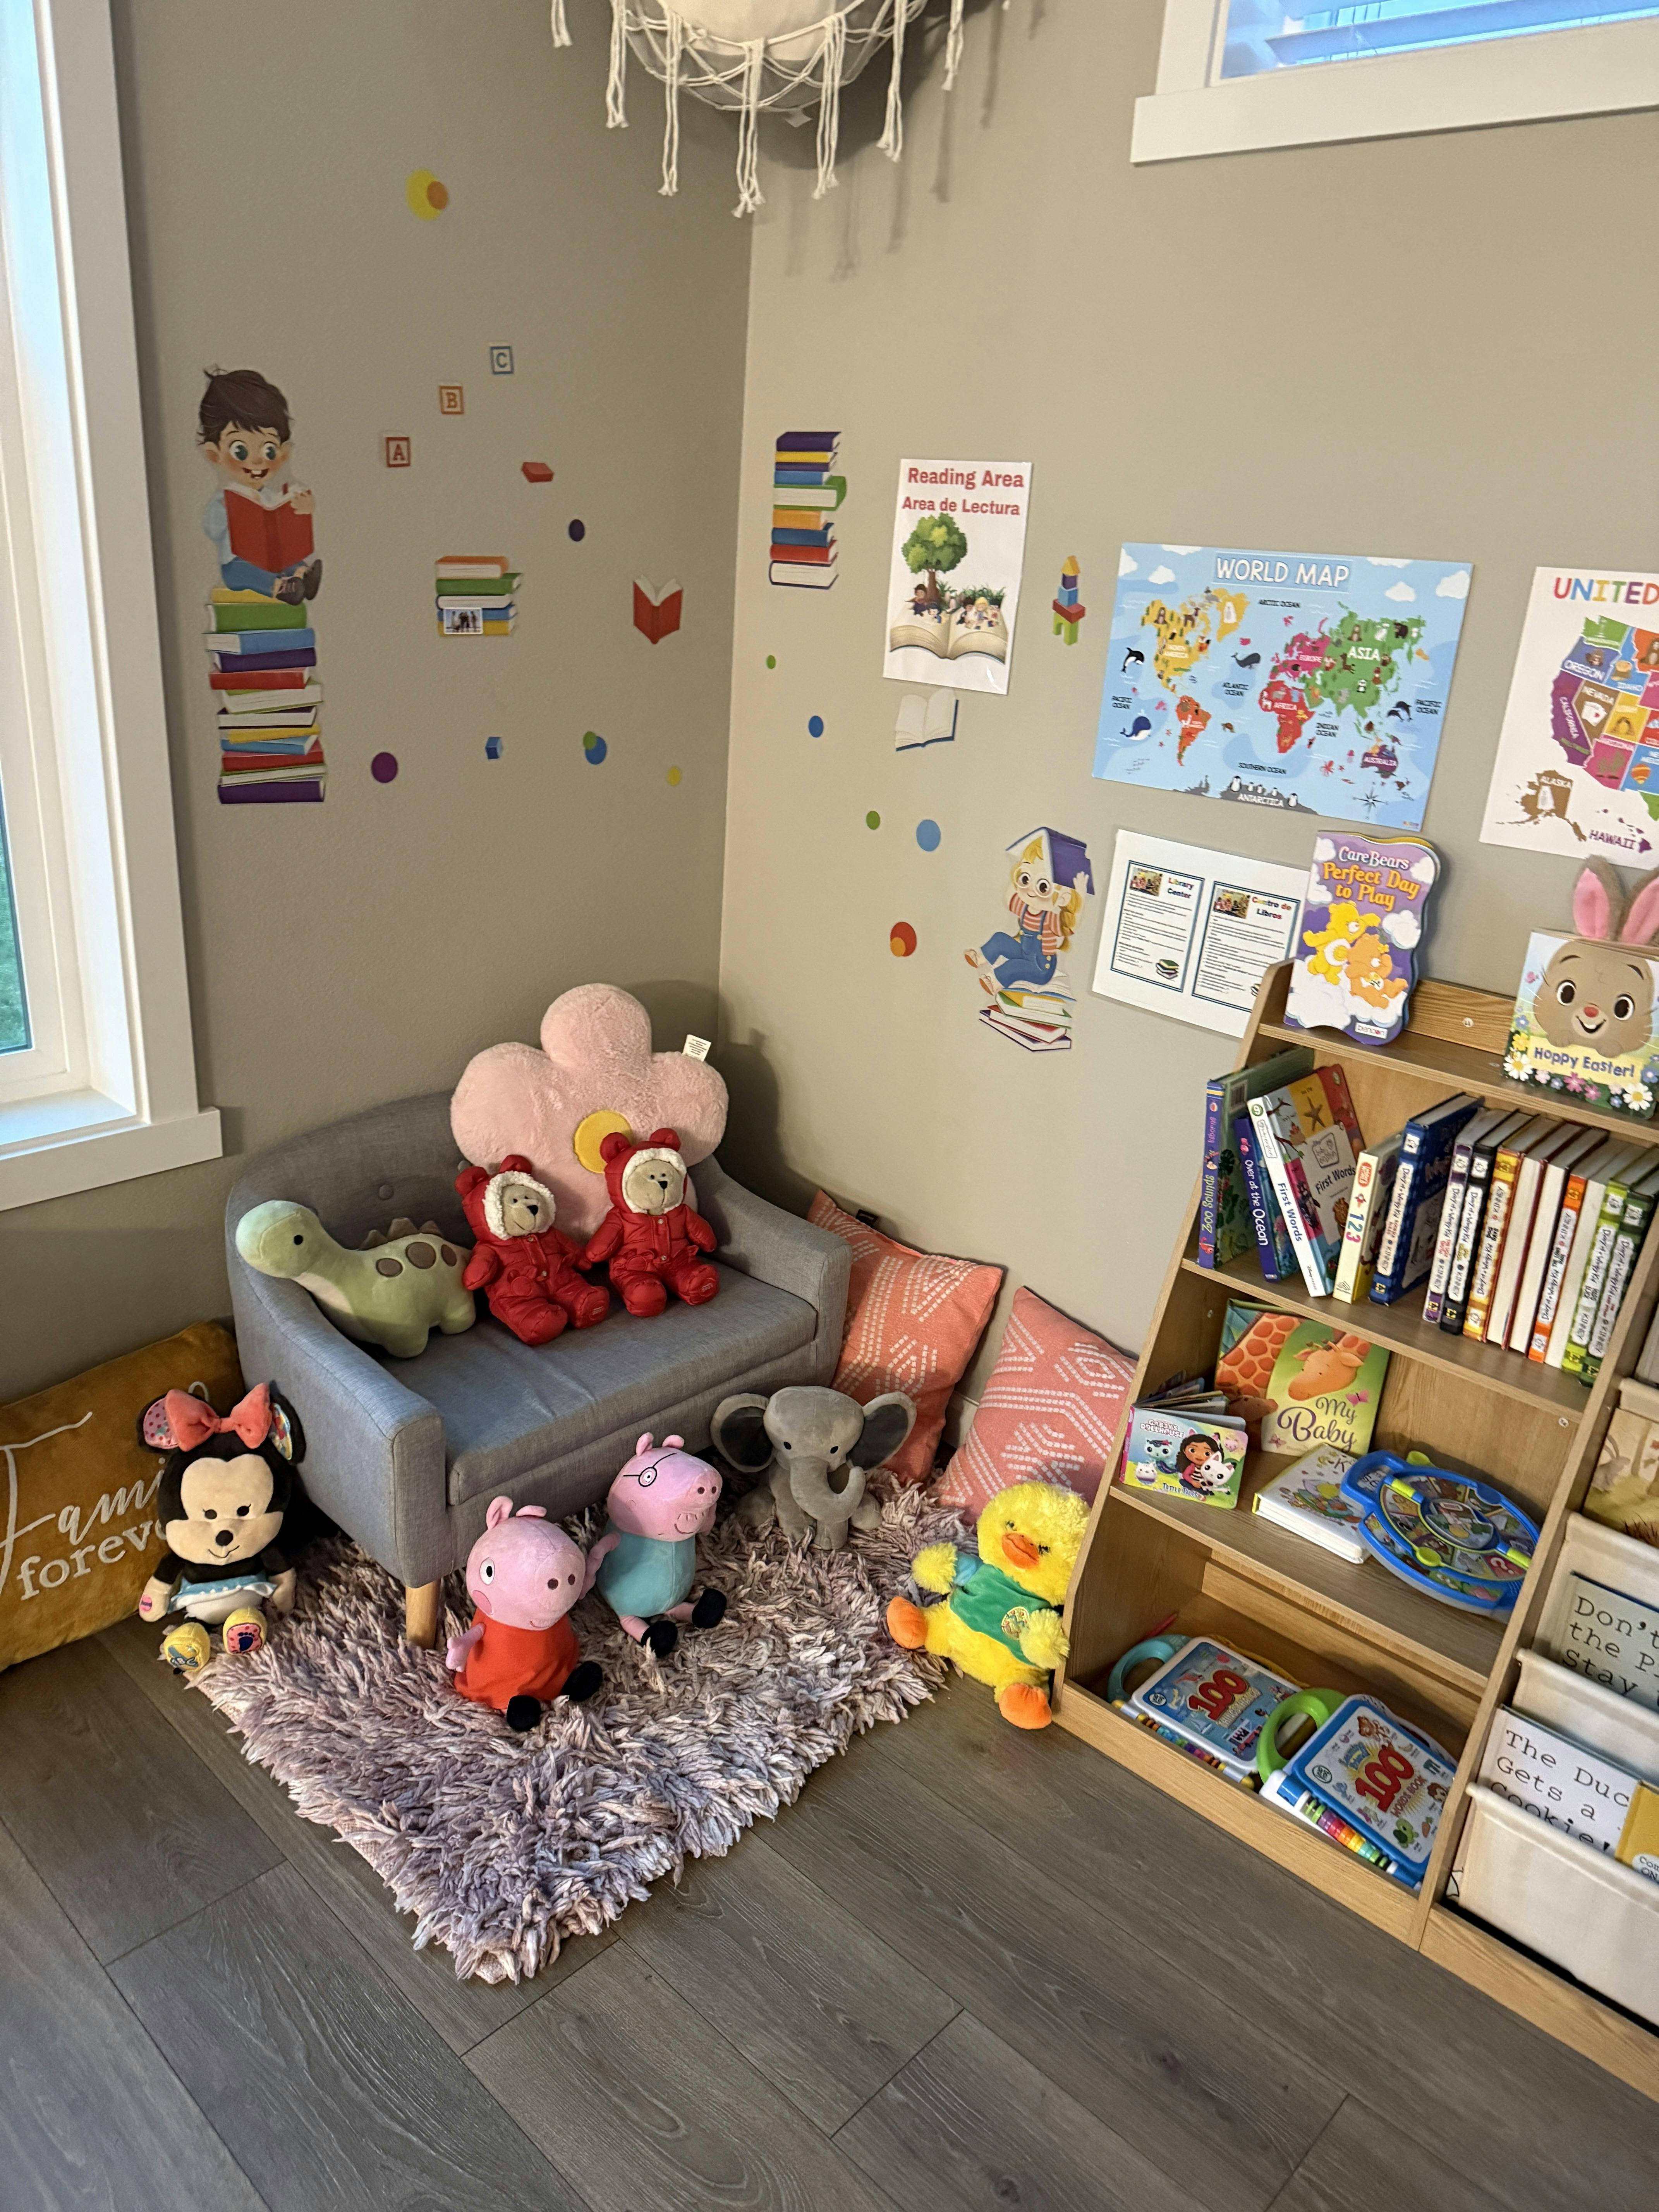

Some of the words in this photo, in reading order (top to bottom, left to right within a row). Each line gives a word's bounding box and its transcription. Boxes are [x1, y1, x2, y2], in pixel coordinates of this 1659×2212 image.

[495, 352, 507, 368] C
[445, 392, 458, 409] B
[392, 443, 405, 460] A
[908, 467, 975, 489] Reading
[982, 470, 1024, 488] Area
[902, 496, 936, 512] Area
[940, 498, 957, 512] de
[962, 499, 1020, 515] Lectura
[1217, 557, 1290, 582] WORLD
[1295, 562, 1350, 588] MAP
[1554, 577, 1659, 605] UNITED
[1347, 646, 1381, 661] ASIA
[1564, 659, 1606, 682] OREGON
[1273, 701, 1298, 711] AFRICA
[1415, 707, 1439, 715] OCEAN
[1315, 730, 1336, 738] OCEAN
[1363, 757, 1397, 767] AUSTRALIA
[1539, 776, 1573, 789] ALASKA
[1237, 793, 1284, 807] ANTARCTICA
[1589, 829, 1636, 850] HAWAII
[1168, 877, 1194, 890] Library
[1322, 861, 1382, 884] Perfect
[1387, 870, 1420, 900] Day
[1167, 888, 1192, 899] Center
[1252, 896, 1279, 908] Centro
[1335, 884, 1353, 899] to
[1357, 885, 1395, 912] Play
[1256, 908, 1283, 920] Libros
[1534, 1046, 1579, 1069] Hoppy
[1582, 1056, 1635, 1077] Easter!
[1244, 1159, 1255, 1180] Over
[1314, 1174, 1333, 1195] First
[1331, 1164, 1356, 1183] Words
[1249, 1181, 1259, 1190] at
[1250, 1192, 1261, 1207] the
[1493, 1186, 1504, 1213] KINNEY
[1201, 1211, 1214, 1234] Zoo
[1277, 1182, 1291, 1207] First
[1286, 1208, 1304, 1242] Words
[1252, 1208, 1269, 1246] Ocean
[1576, 1313, 1589, 1341] KINNEY
[1595, 1325, 1608, 1353] KINNEY
[1315, 1396, 1358, 1425] My
[1140, 1422, 1184, 1438] DOLLHOUSE
[1277, 1406, 1358, 1453] Baby
[16, 1518, 167, 1601] forev
[1574, 1595, 1659, 1650] Don't
[1570, 1621, 1621, 1659] the
[1188, 1669, 1248, 1721] 100
[1355, 1742, 1415, 1813] 100
[1506, 1729, 1557, 1768] The
[1573, 1765, 1630, 1808] Duc
[1390, 1793, 1412, 1818] WORDS
[1407, 1774, 1428, 1795] BOOK
[1497, 1756, 1563, 1802] Gets
[1580, 1803, 1596, 1821] a
